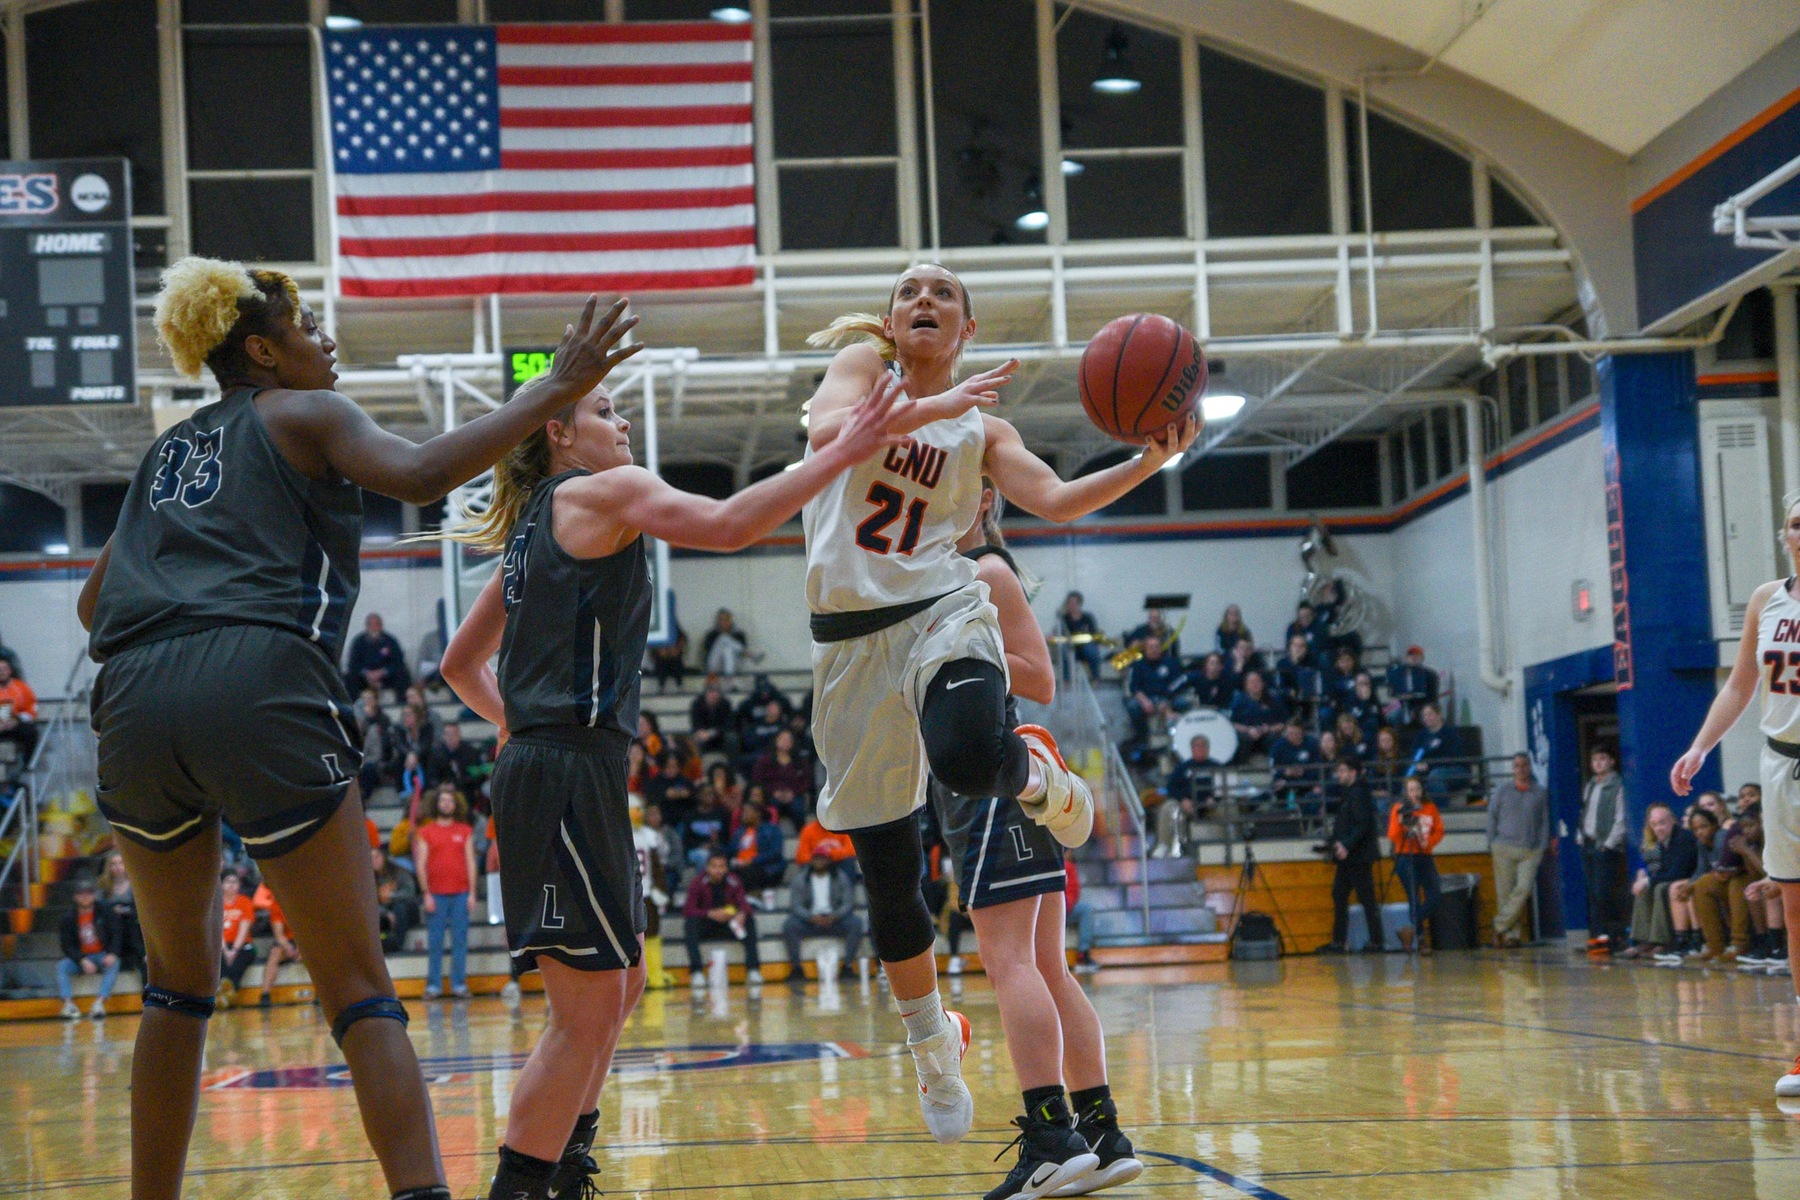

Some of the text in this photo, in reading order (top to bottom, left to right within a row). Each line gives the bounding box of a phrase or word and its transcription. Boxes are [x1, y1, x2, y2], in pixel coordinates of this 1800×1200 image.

[35, 232, 105, 254] HOME
[883, 440, 949, 490] CNU
[855, 480, 929, 556] 21
[1773, 618, 1800, 643] CN
[1008, 825, 1034, 861] L
[541, 884, 565, 929] L
